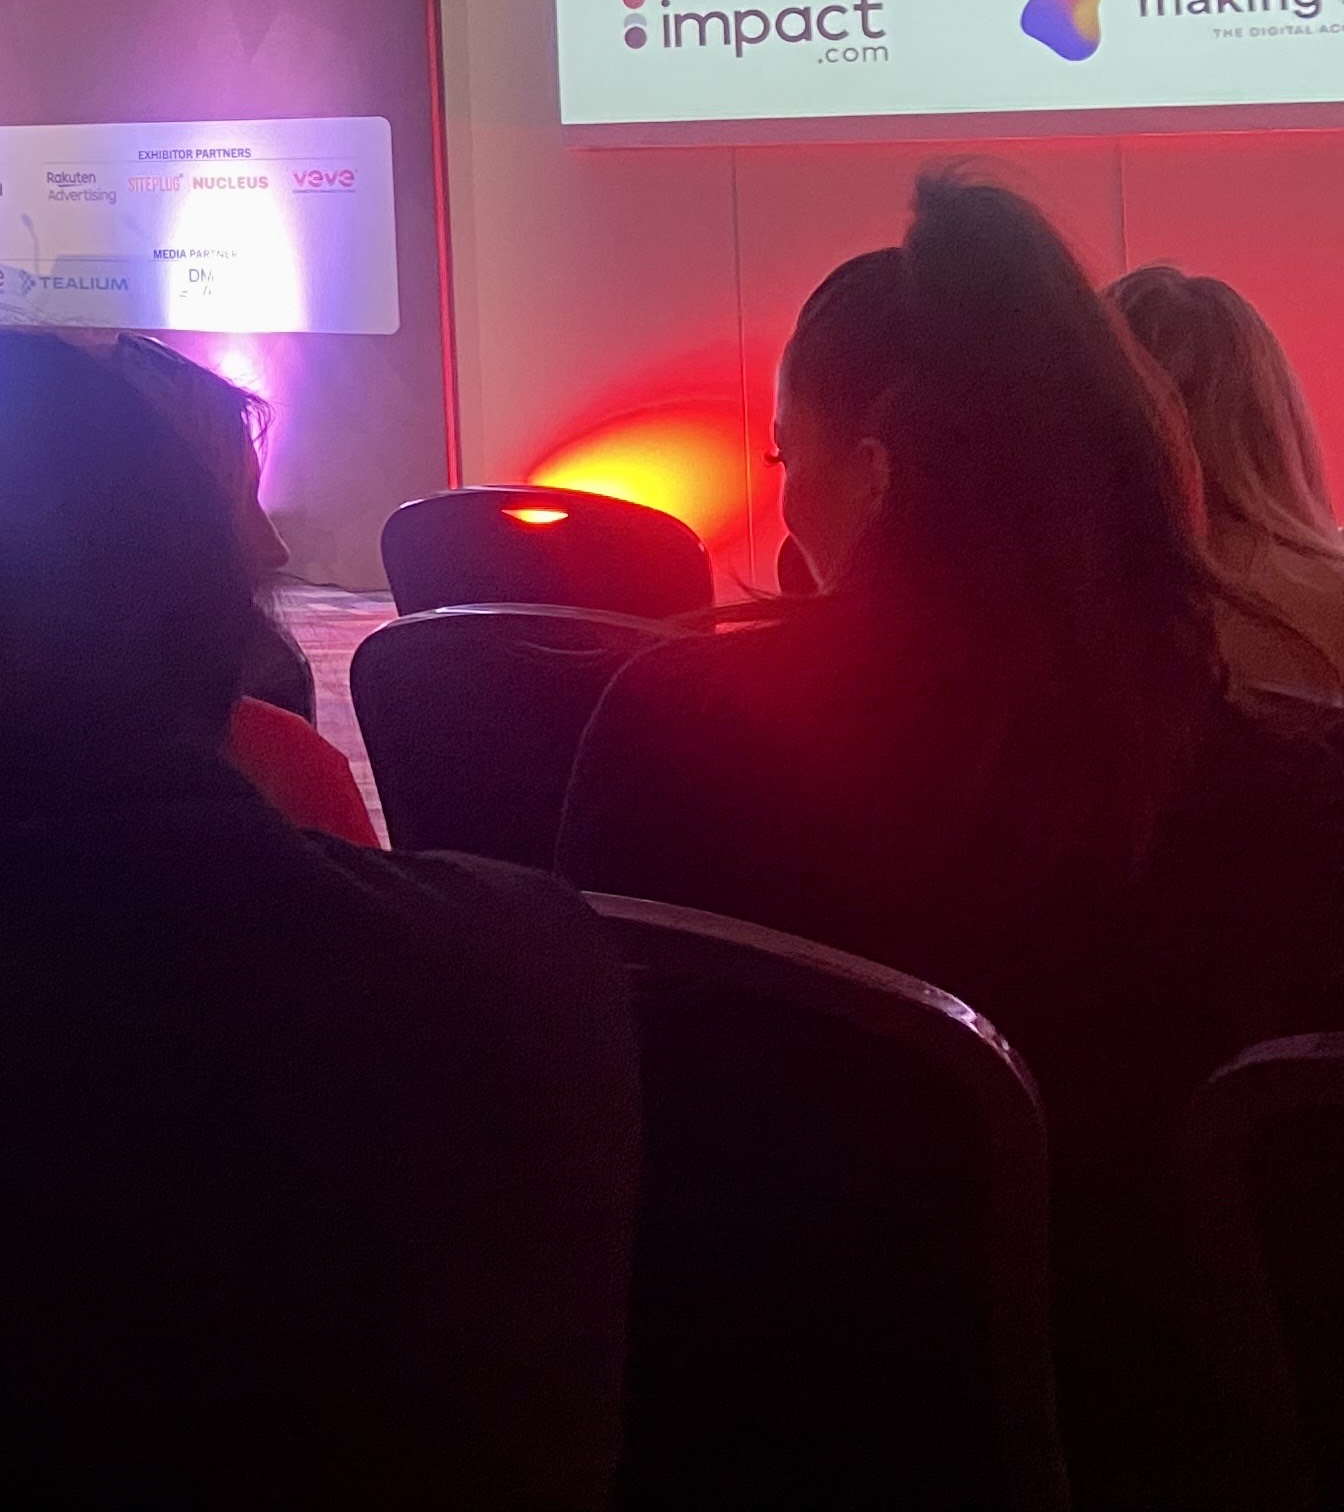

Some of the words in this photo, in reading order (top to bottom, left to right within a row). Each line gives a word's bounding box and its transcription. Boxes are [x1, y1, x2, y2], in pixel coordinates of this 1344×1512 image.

[1213, 28, 1243, 38] THE
[1249, 25, 1313, 38] DIGITAL
[817, 40, 889, 64] .com
[138, 149, 193, 160] EXHIBITOR
[196, 148, 251, 159] PARTNERS
[46, 171, 97, 185] Rakuten
[192, 176, 269, 190] NUCLEUS
[48, 189, 117, 204] Advertising
[153, 249, 186, 259] MEDIA
[39, 277, 128, 291] TEALIUM
